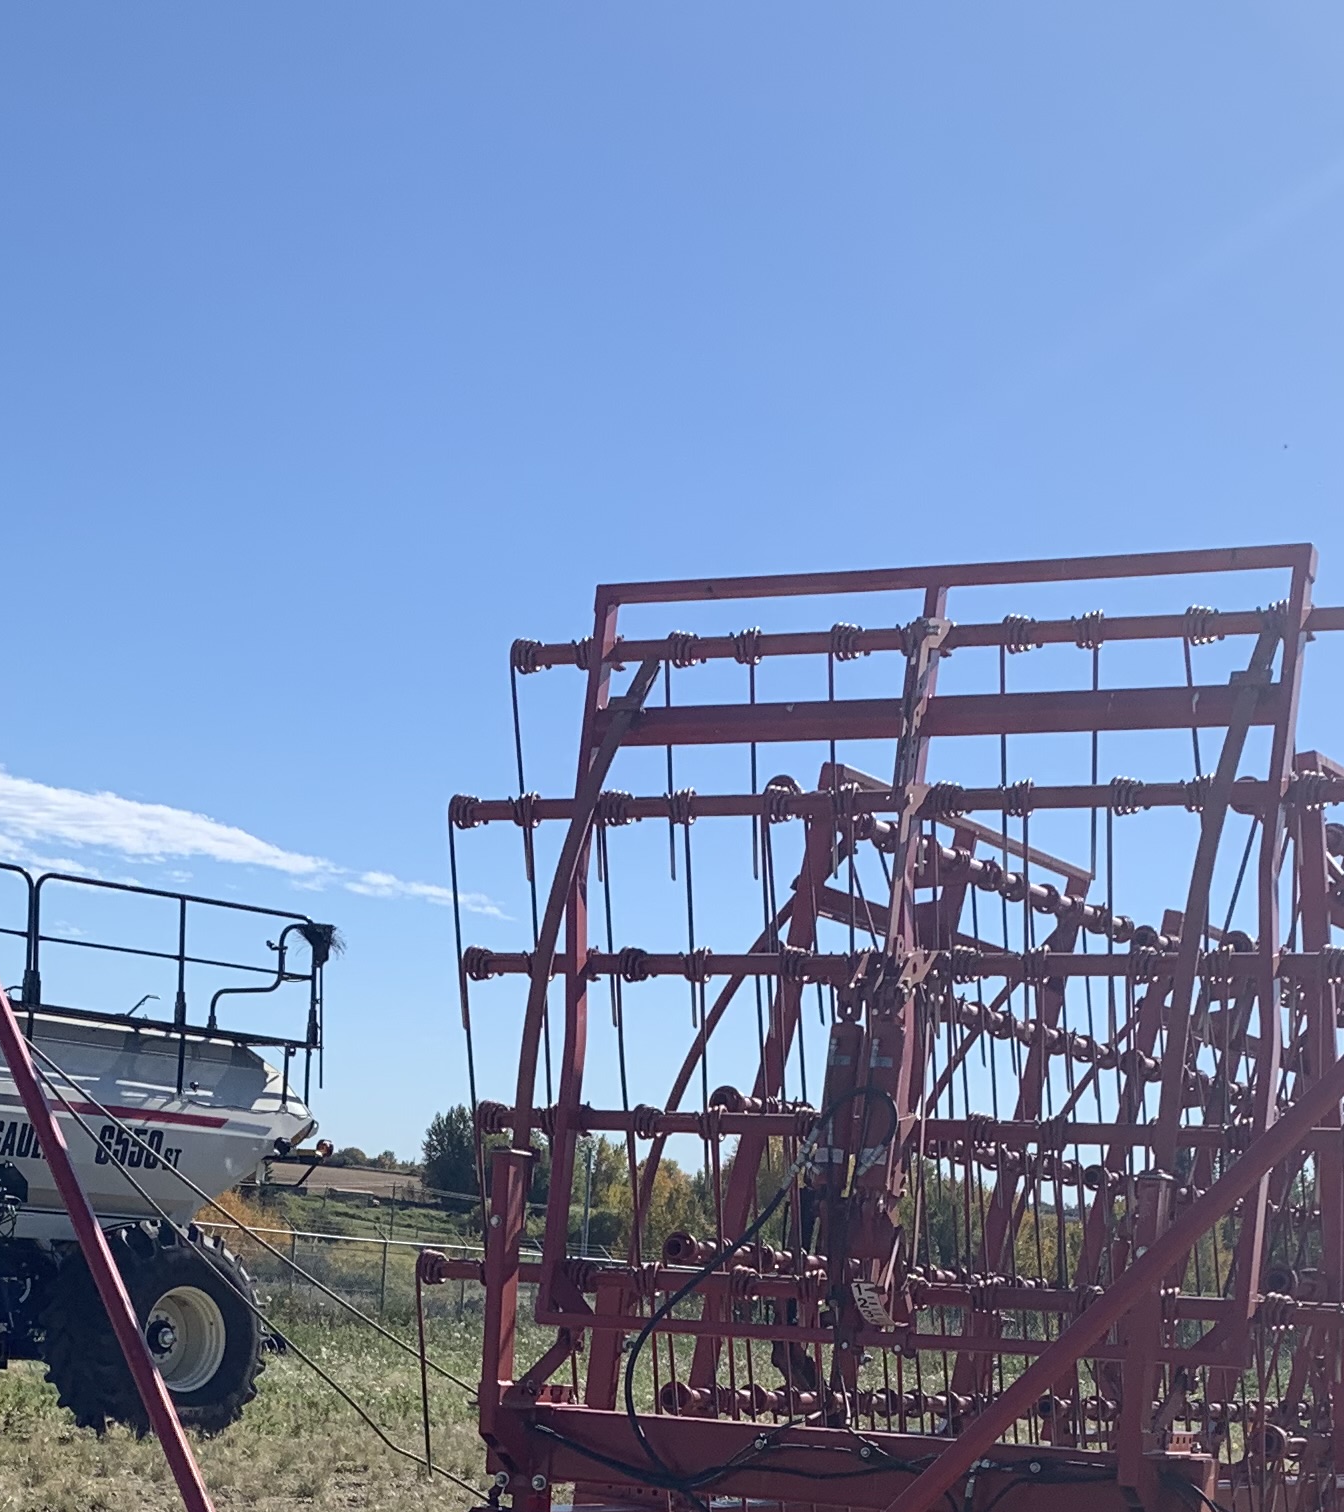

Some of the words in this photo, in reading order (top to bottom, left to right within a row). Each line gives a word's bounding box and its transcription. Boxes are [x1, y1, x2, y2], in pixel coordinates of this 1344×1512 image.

[95, 1125, 164, 1169] 6550
[162, 1147, 183, 1171] ST
[854, 1284, 862, 1296] 1
[858, 1298, 869, 1309] 2
